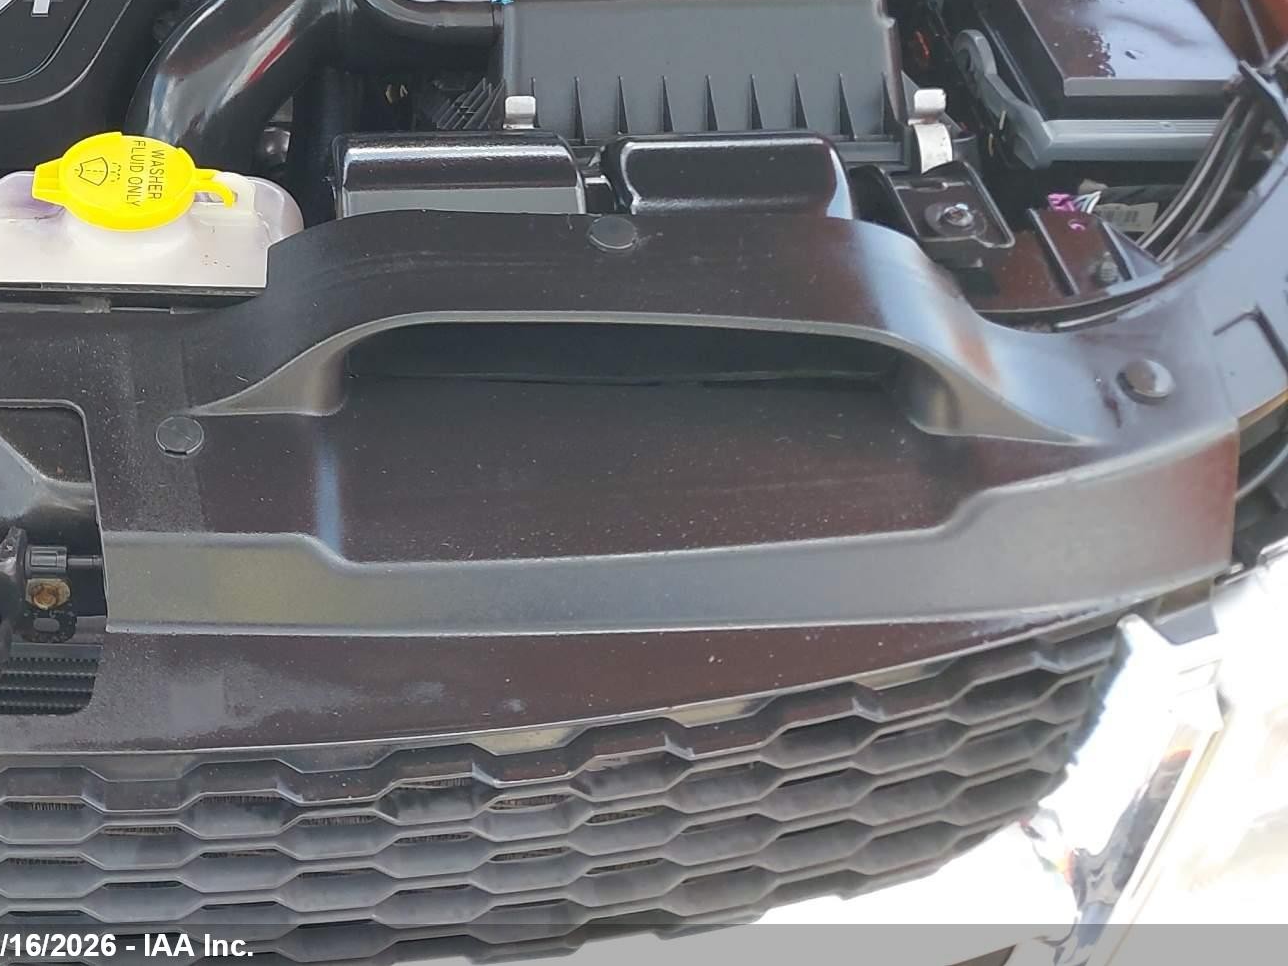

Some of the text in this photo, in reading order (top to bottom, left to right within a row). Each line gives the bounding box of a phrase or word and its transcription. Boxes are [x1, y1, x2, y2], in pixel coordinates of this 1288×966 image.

[126, 139, 146, 208] FLUID ONLY
[147, 148, 166, 201] WASHER
